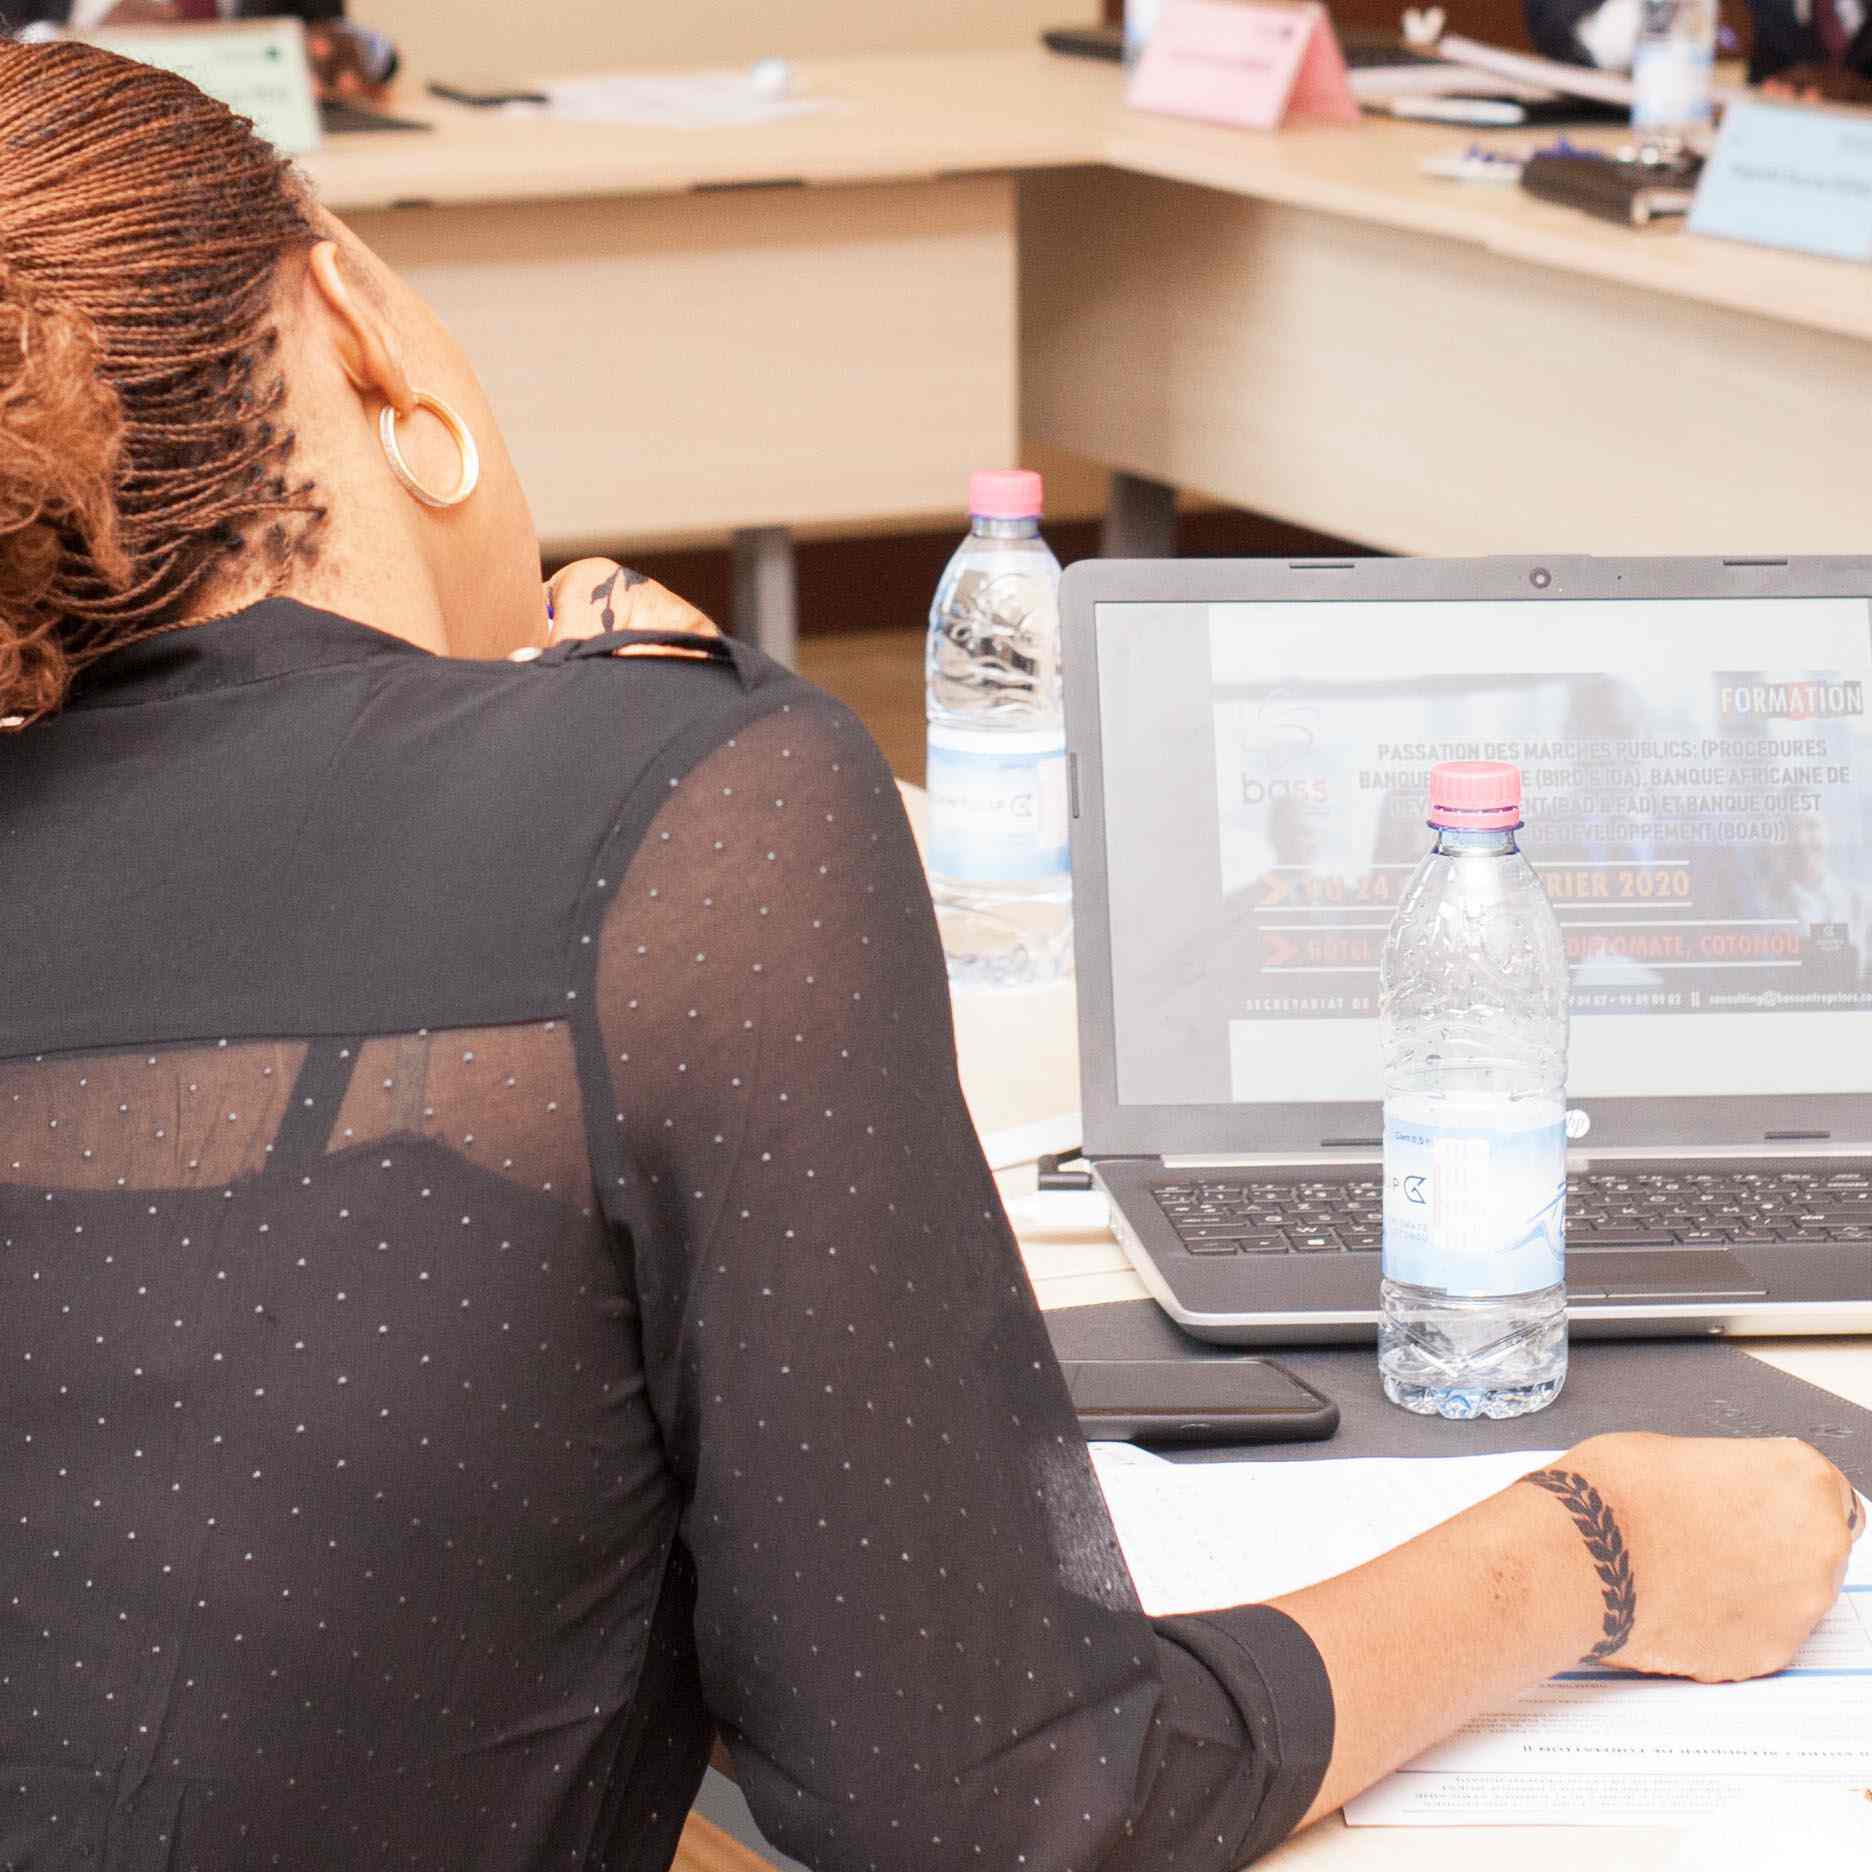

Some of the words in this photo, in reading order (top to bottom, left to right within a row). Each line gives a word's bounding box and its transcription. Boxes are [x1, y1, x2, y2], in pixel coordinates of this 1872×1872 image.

[1719, 684, 1863, 714] FORMATION
[1377, 742, 1480, 761] PASSATION
[1484, 741, 1520, 760] DES
[1524, 742, 1611, 760] MARCHES
[1702, 738, 1828, 760] (PROCEDURES
[1359, 769, 1430, 790] BANQUE
[1650, 766, 1730, 787] BANQUE
[1730, 764, 1824, 786] AFRICAINE
[1827, 764, 1850, 784] DE
[1662, 794, 1684, 812] ET
[1686, 793, 1760, 813] BANQUE
[1765, 792, 1823, 812] OUEST
[1617, 871, 1691, 897] 2020
[1697, 931, 1800, 957] COTONOU
